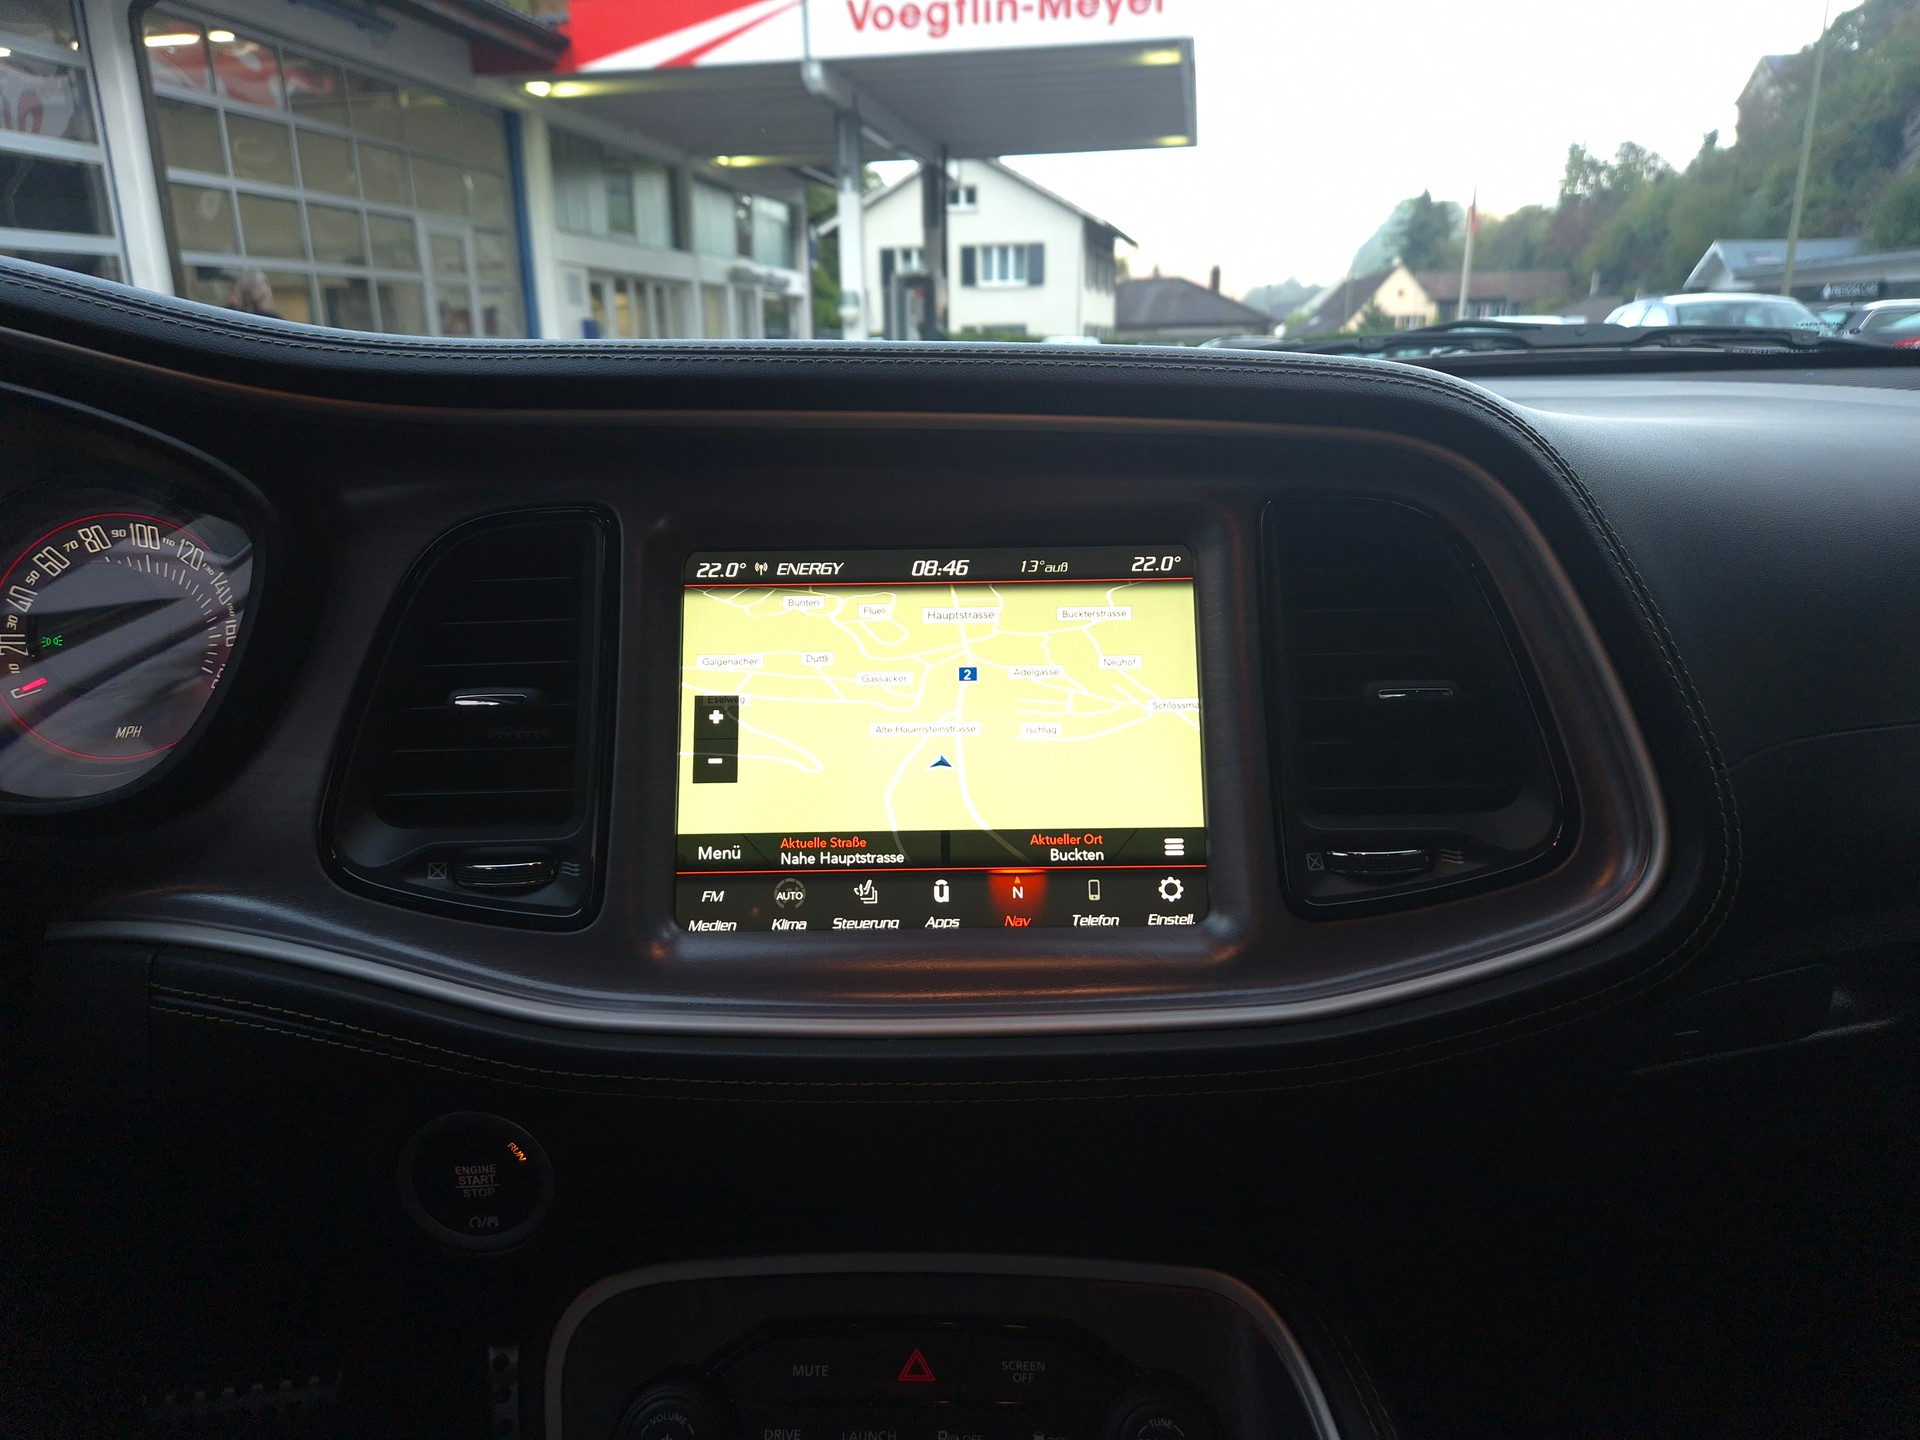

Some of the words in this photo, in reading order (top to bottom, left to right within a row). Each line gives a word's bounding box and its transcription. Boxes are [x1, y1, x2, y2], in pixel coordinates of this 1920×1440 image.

[78, 525, 112, 553] 80
[111, 529, 127, 538] 90
[130, 523, 161, 550] 100
[63, 540, 79, 553] 70
[162, 537, 176, 547] 110
[177, 538, 205, 571] 120
[33, 546, 71, 577] 60
[202, 562, 215, 576] 130
[776, 562, 844, 576] ENERGY
[911, 559, 970, 577] 08:46
[26, 570, 40, 586] 50
[210, 571, 233, 605] 140
[6, 585, 38, 613] 40
[927, 609, 995, 621] Hauptstrasse
[1062, 608, 1127, 618] Buckterstrasse
[7, 614, 18, 631] 30
[1103, 658, 1136, 666] Neuhof
[8, 663, 21, 674] 10
[861, 674, 907, 683] Gassacker
[963, 669, 972, 681] 2
[116, 725, 143, 739] MPH
[780, 837, 827, 849] Aktuelle
[830, 836, 867, 848] Straße
[1030, 834, 1081, 845] Aktueller
[1083, 833, 1103, 845] Ort
[698, 845, 741, 860] Menü
[1050, 848, 1104, 862] Buckten
[780, 852, 816, 865] Nahe
[820, 851, 905, 867] Hauptstrasse
[701, 890, 724, 902] FM
[776, 891, 803, 901] AUTO
[1012, 886, 1024, 899] N
[771, 919, 807, 931] Klima
[832, 917, 900, 930] Steuerung
[925, 916, 960, 928] Apps
[1004, 915, 1031, 927] Nav
[1072, 914, 1120, 926] Telefon
[1147, 913, 1196, 926] Einstell.
[688, 920, 737, 932] Medien
[507, 1141, 527, 1161] RUN
[455, 1164, 497, 1175] ENGINE
[458, 1174, 495, 1186] START
[463, 1187, 495, 1198] STOP
[792, 1365, 829, 1377] MUTE
[1002, 1360, 1046, 1372] SCREEN
[1012, 1372, 1036, 1383] OFF
[650, 1412, 688, 1426] VOLUME
[1149, 1417, 1174, 1429] TUNE
[764, 1429, 801, 1440] DRIVE
